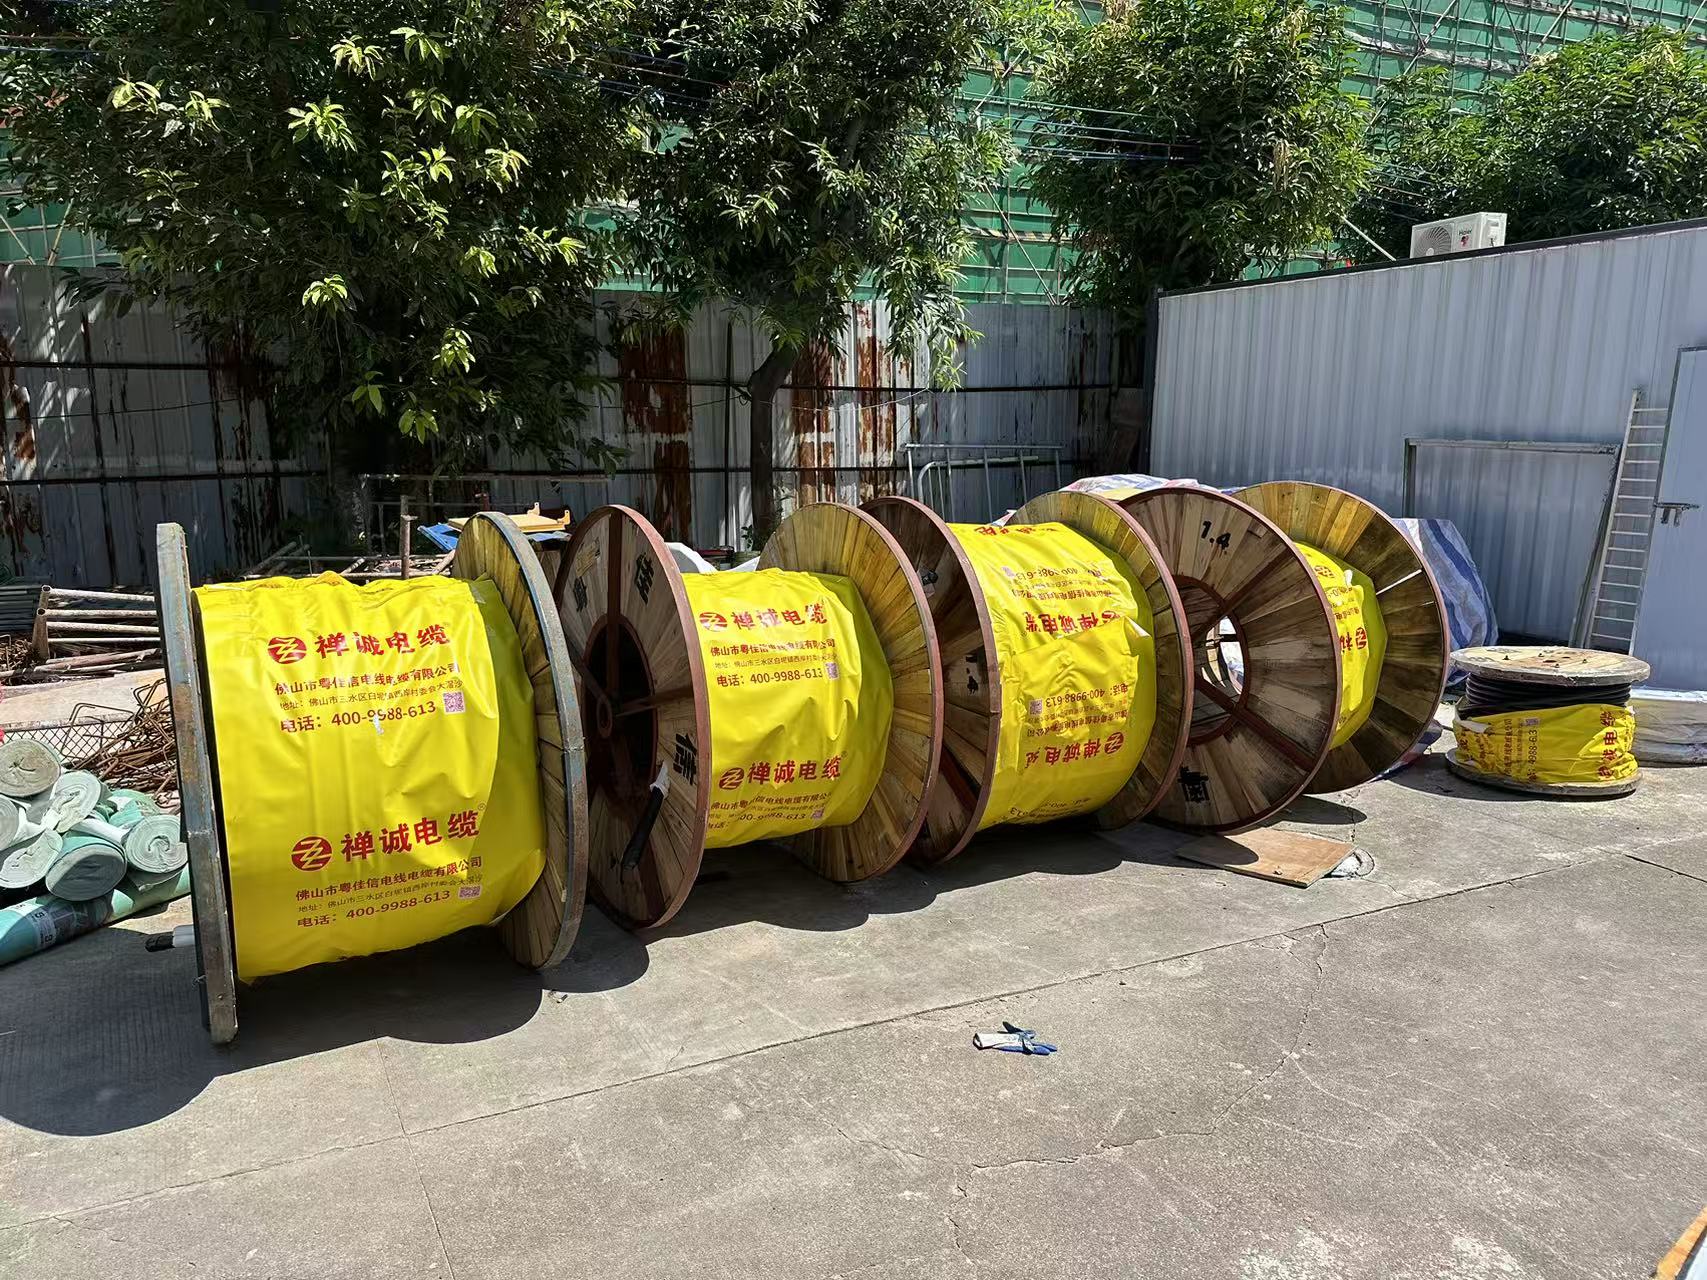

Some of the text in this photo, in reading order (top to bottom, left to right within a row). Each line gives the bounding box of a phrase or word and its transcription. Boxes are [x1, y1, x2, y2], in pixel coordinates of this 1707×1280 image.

[1201, 520, 1231, 550] 1.4
[731, 602, 828, 630] 禅诚电缆
[314, 624, 450, 659] 禅诚电缆
[274, 663, 460, 696] 佛山市粤佳信电线电缆有限公司
[748, 755, 841, 785] 禅诚电缆
[340, 809, 480, 863] 禅诚电缆
[296, 856, 482, 901] 佛山市粤佳信电线电缆有限公司
